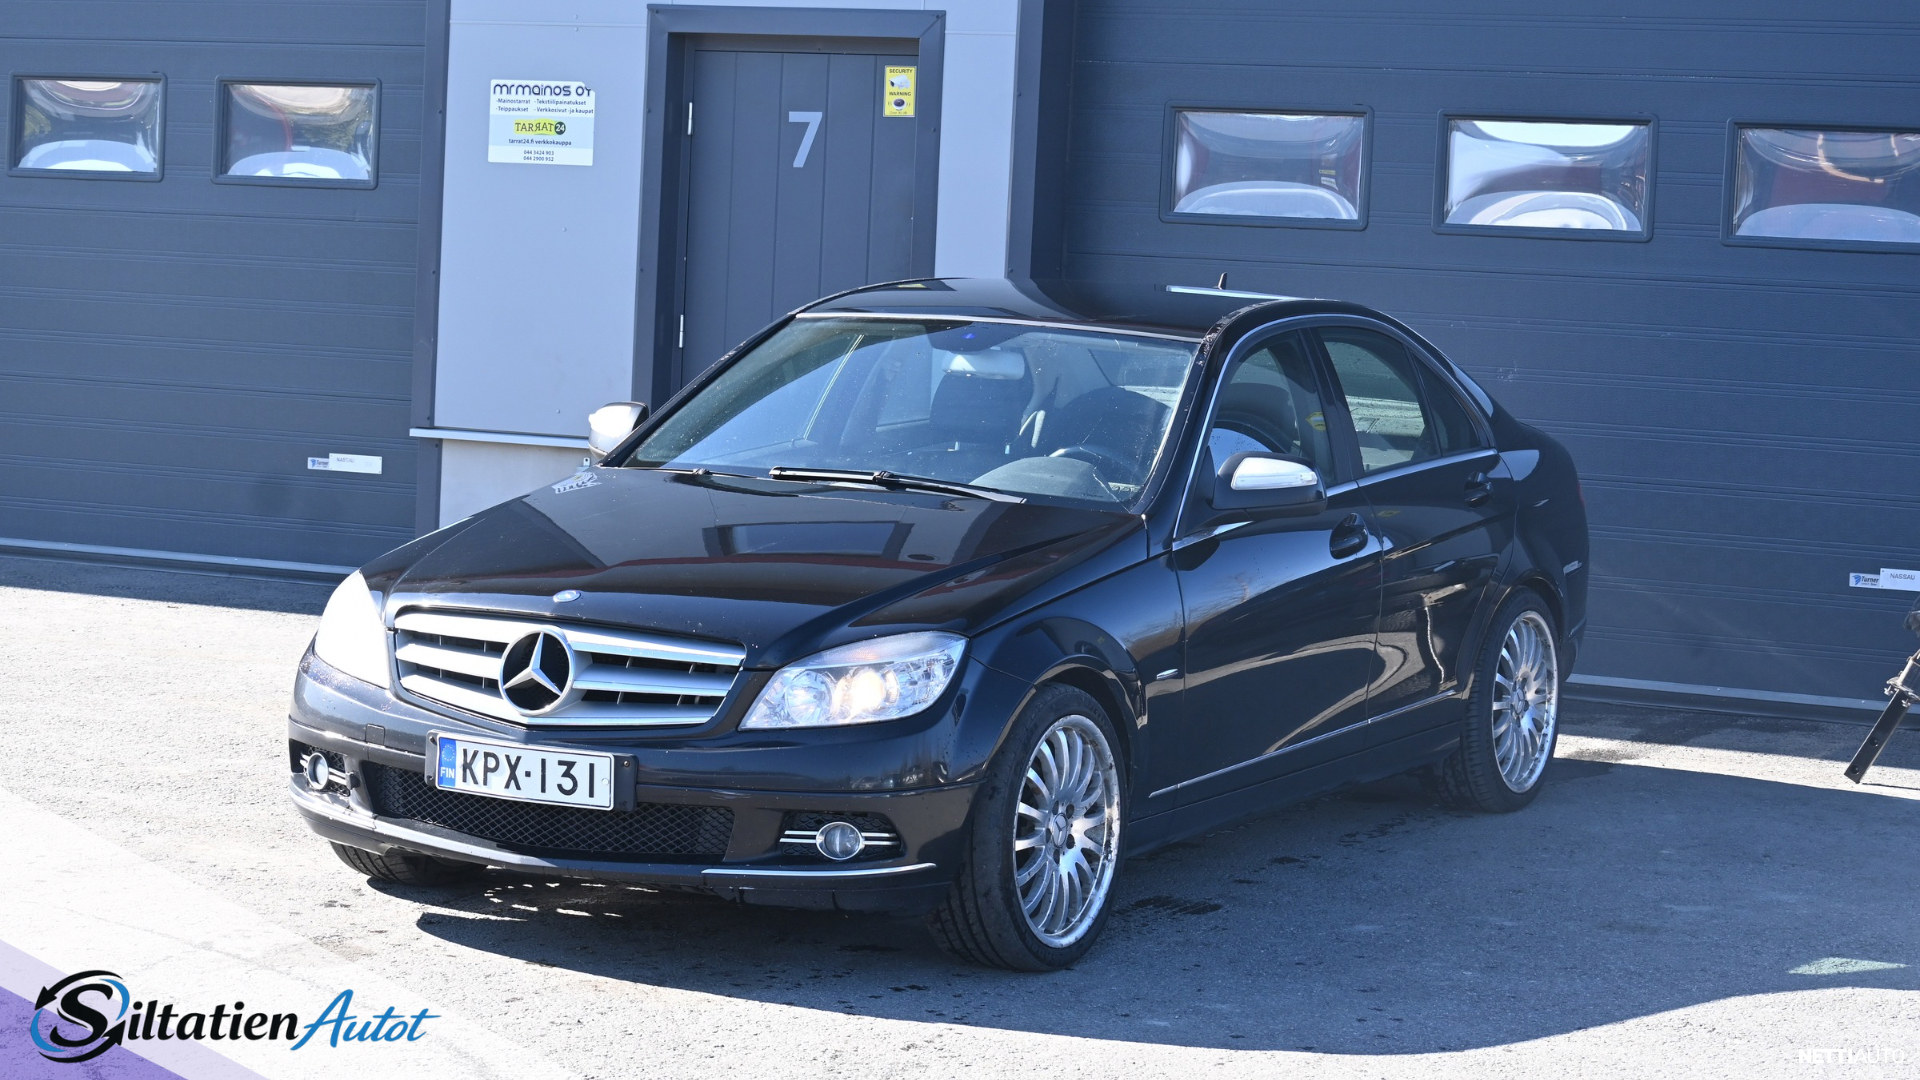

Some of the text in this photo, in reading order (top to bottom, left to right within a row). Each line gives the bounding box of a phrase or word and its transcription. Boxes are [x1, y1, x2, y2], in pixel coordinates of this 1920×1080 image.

[493, 84, 571, 96] mrmainos
[788, 111, 823, 168] 7
[440, 766, 455, 779] FIN
[462, 748, 595, 798] KPX-131
